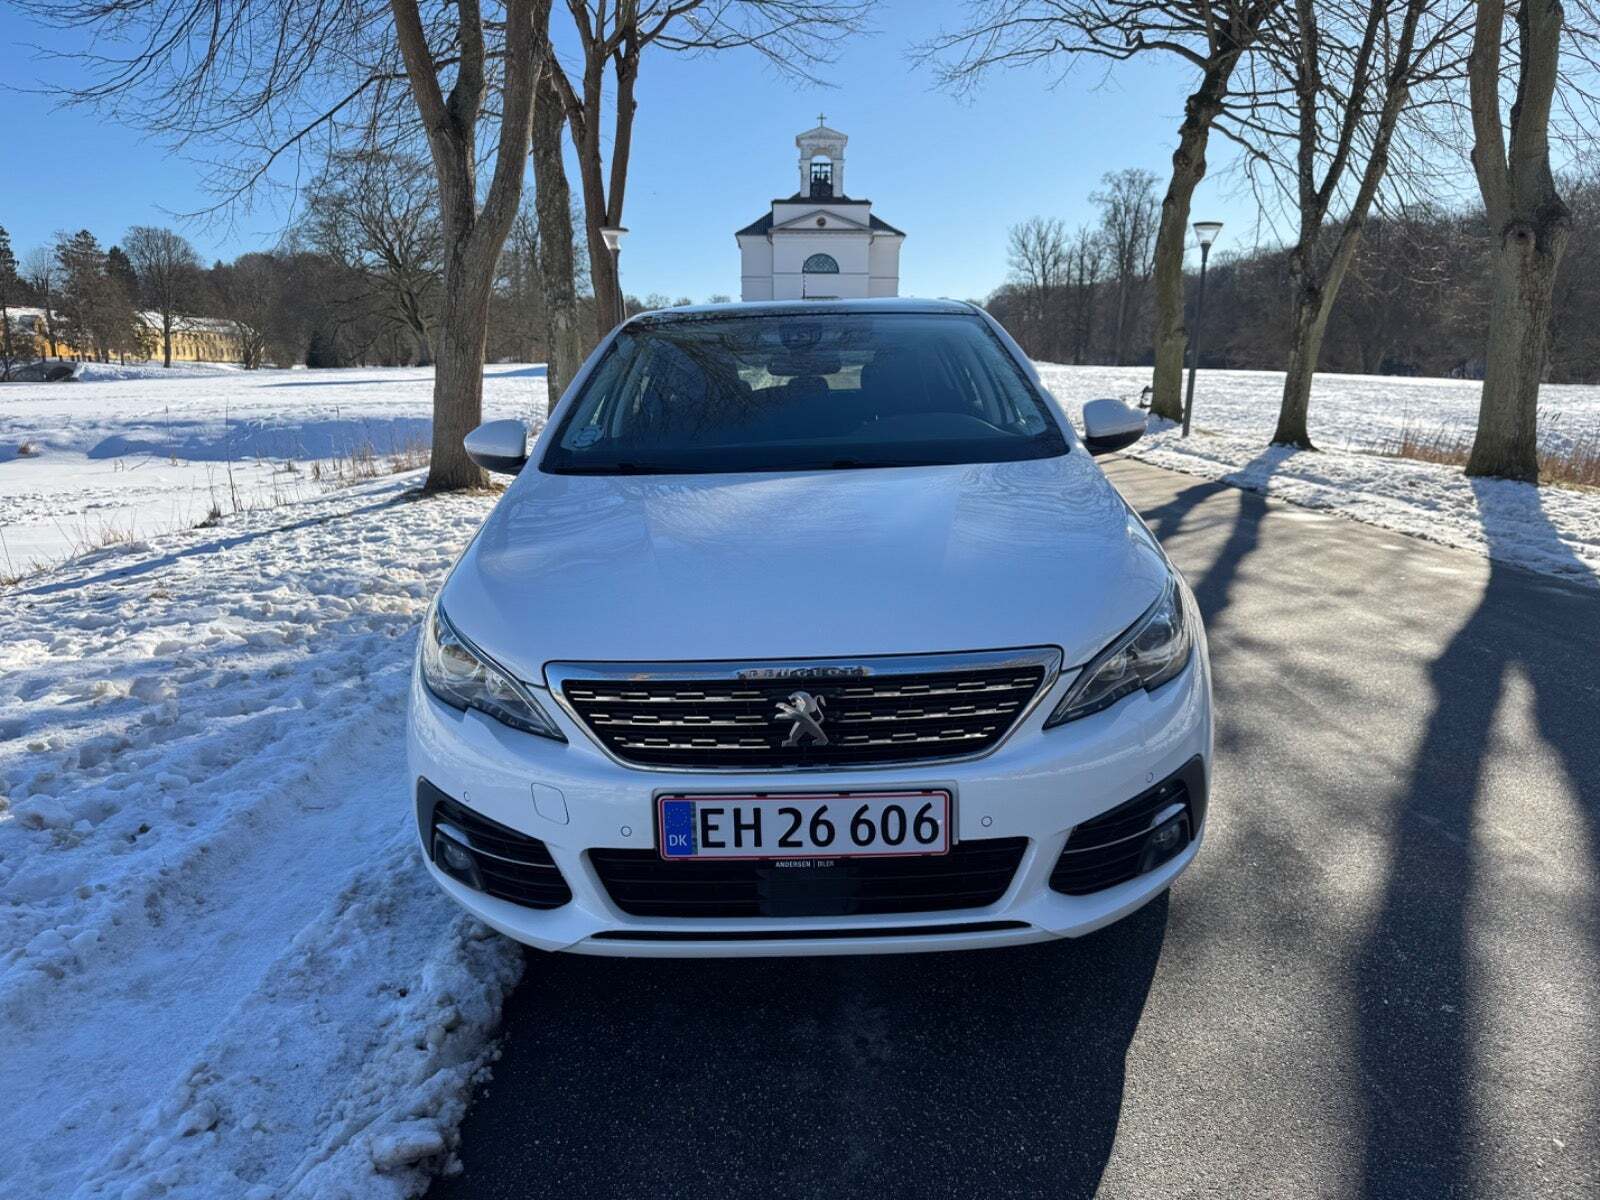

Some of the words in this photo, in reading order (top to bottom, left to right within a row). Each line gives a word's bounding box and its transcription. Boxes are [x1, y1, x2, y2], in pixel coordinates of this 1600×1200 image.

[669, 834, 688, 847] DK
[700, 807, 762, 849] EH
[778, 804, 836, 848] 26
[850, 802, 940, 847] 606
